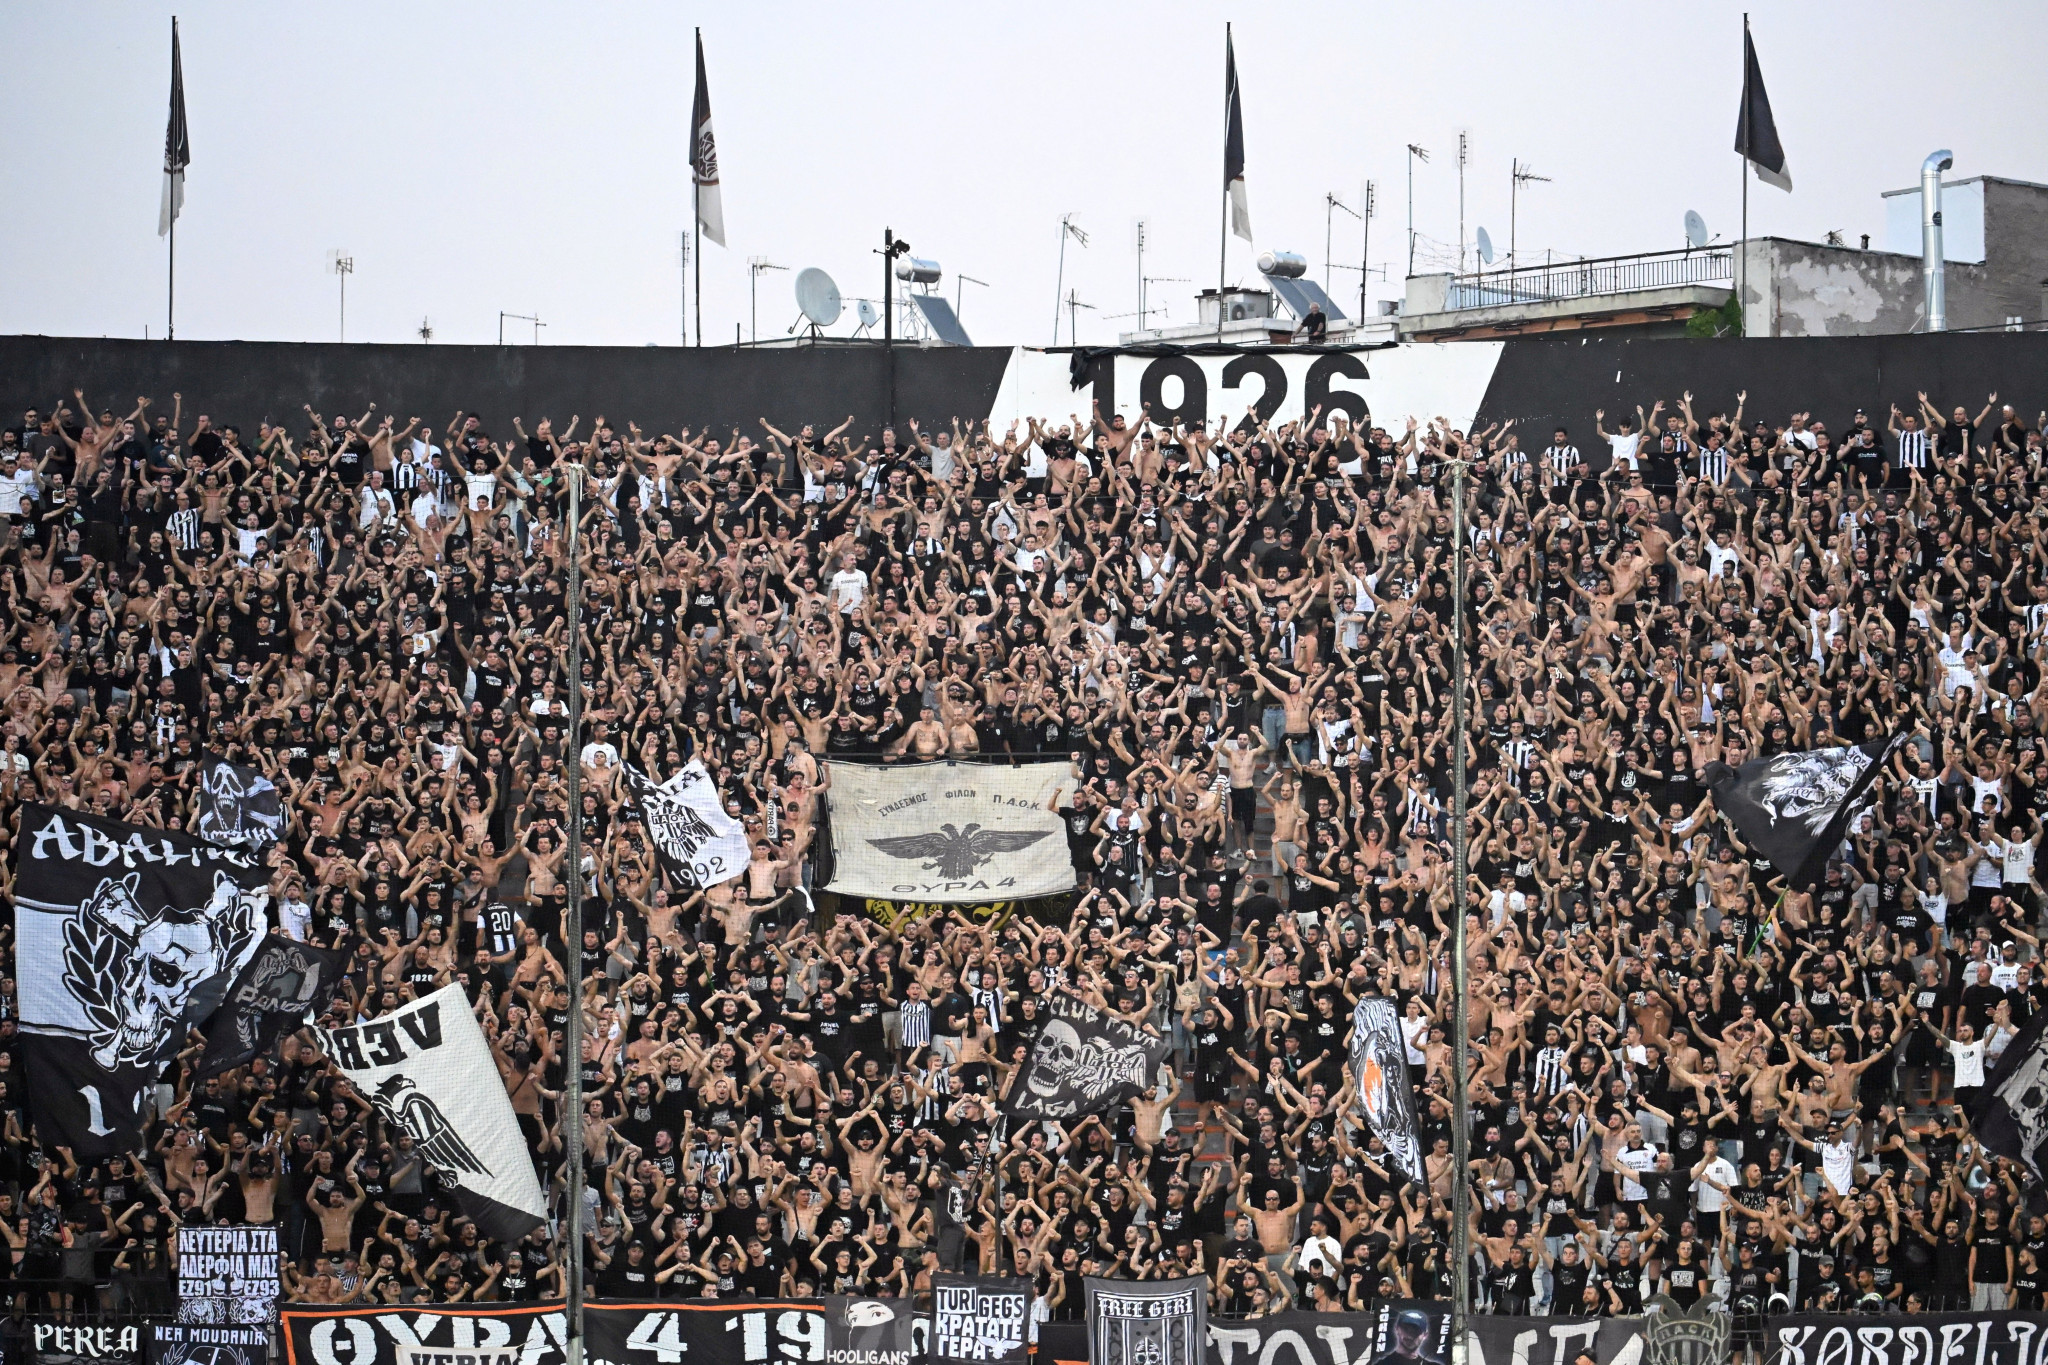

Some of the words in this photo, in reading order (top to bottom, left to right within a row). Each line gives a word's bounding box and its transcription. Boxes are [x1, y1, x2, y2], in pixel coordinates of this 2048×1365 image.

[1080, 354, 1370, 463] 1926
[878, 792, 927, 817] ΣΥΝΔΕΣΜΟΣ
[945, 789, 976, 799] ΦΙΛΩΝ
[671, 856, 727, 887] 1992
[892, 880, 990, 893] ΘΥΡΑ
[996, 877, 1016, 887] 4
[491, 912, 510, 931] 20
[1050, 996, 1099, 1023] CLUB
[179, 1230, 247, 1253] ΛΕΥΤΕΡΙΑ
[251, 1230, 278, 1253] ΣΤΑ
[179, 1255, 244, 1278] ΑΔΕΡΦΙΑ
[248, 1255, 278, 1278] ΜΑΣ
[179, 1279, 212, 1297] EZ91
[244, 1279, 280, 1297] EZ93
[937, 1288, 976, 1311] TURI
[978, 1296, 1024, 1319] GEGS
[1097, 1296, 1144, 1318] FREE
[155, 1326, 183, 1342] NEA
[190, 1328, 263, 1346] MOUDANIA
[626, 1311, 688, 1363] 4
[936, 1313, 1023, 1340] ΚΡΑΤΑΤΕ
[1376, 1304, 1389, 1353] JOHAN
[34, 1323, 138, 1359] PEREA
[938, 1335, 986, 1360] ΓΕΡΑ
[826, 1349, 910, 1365] HOOLIGANS
